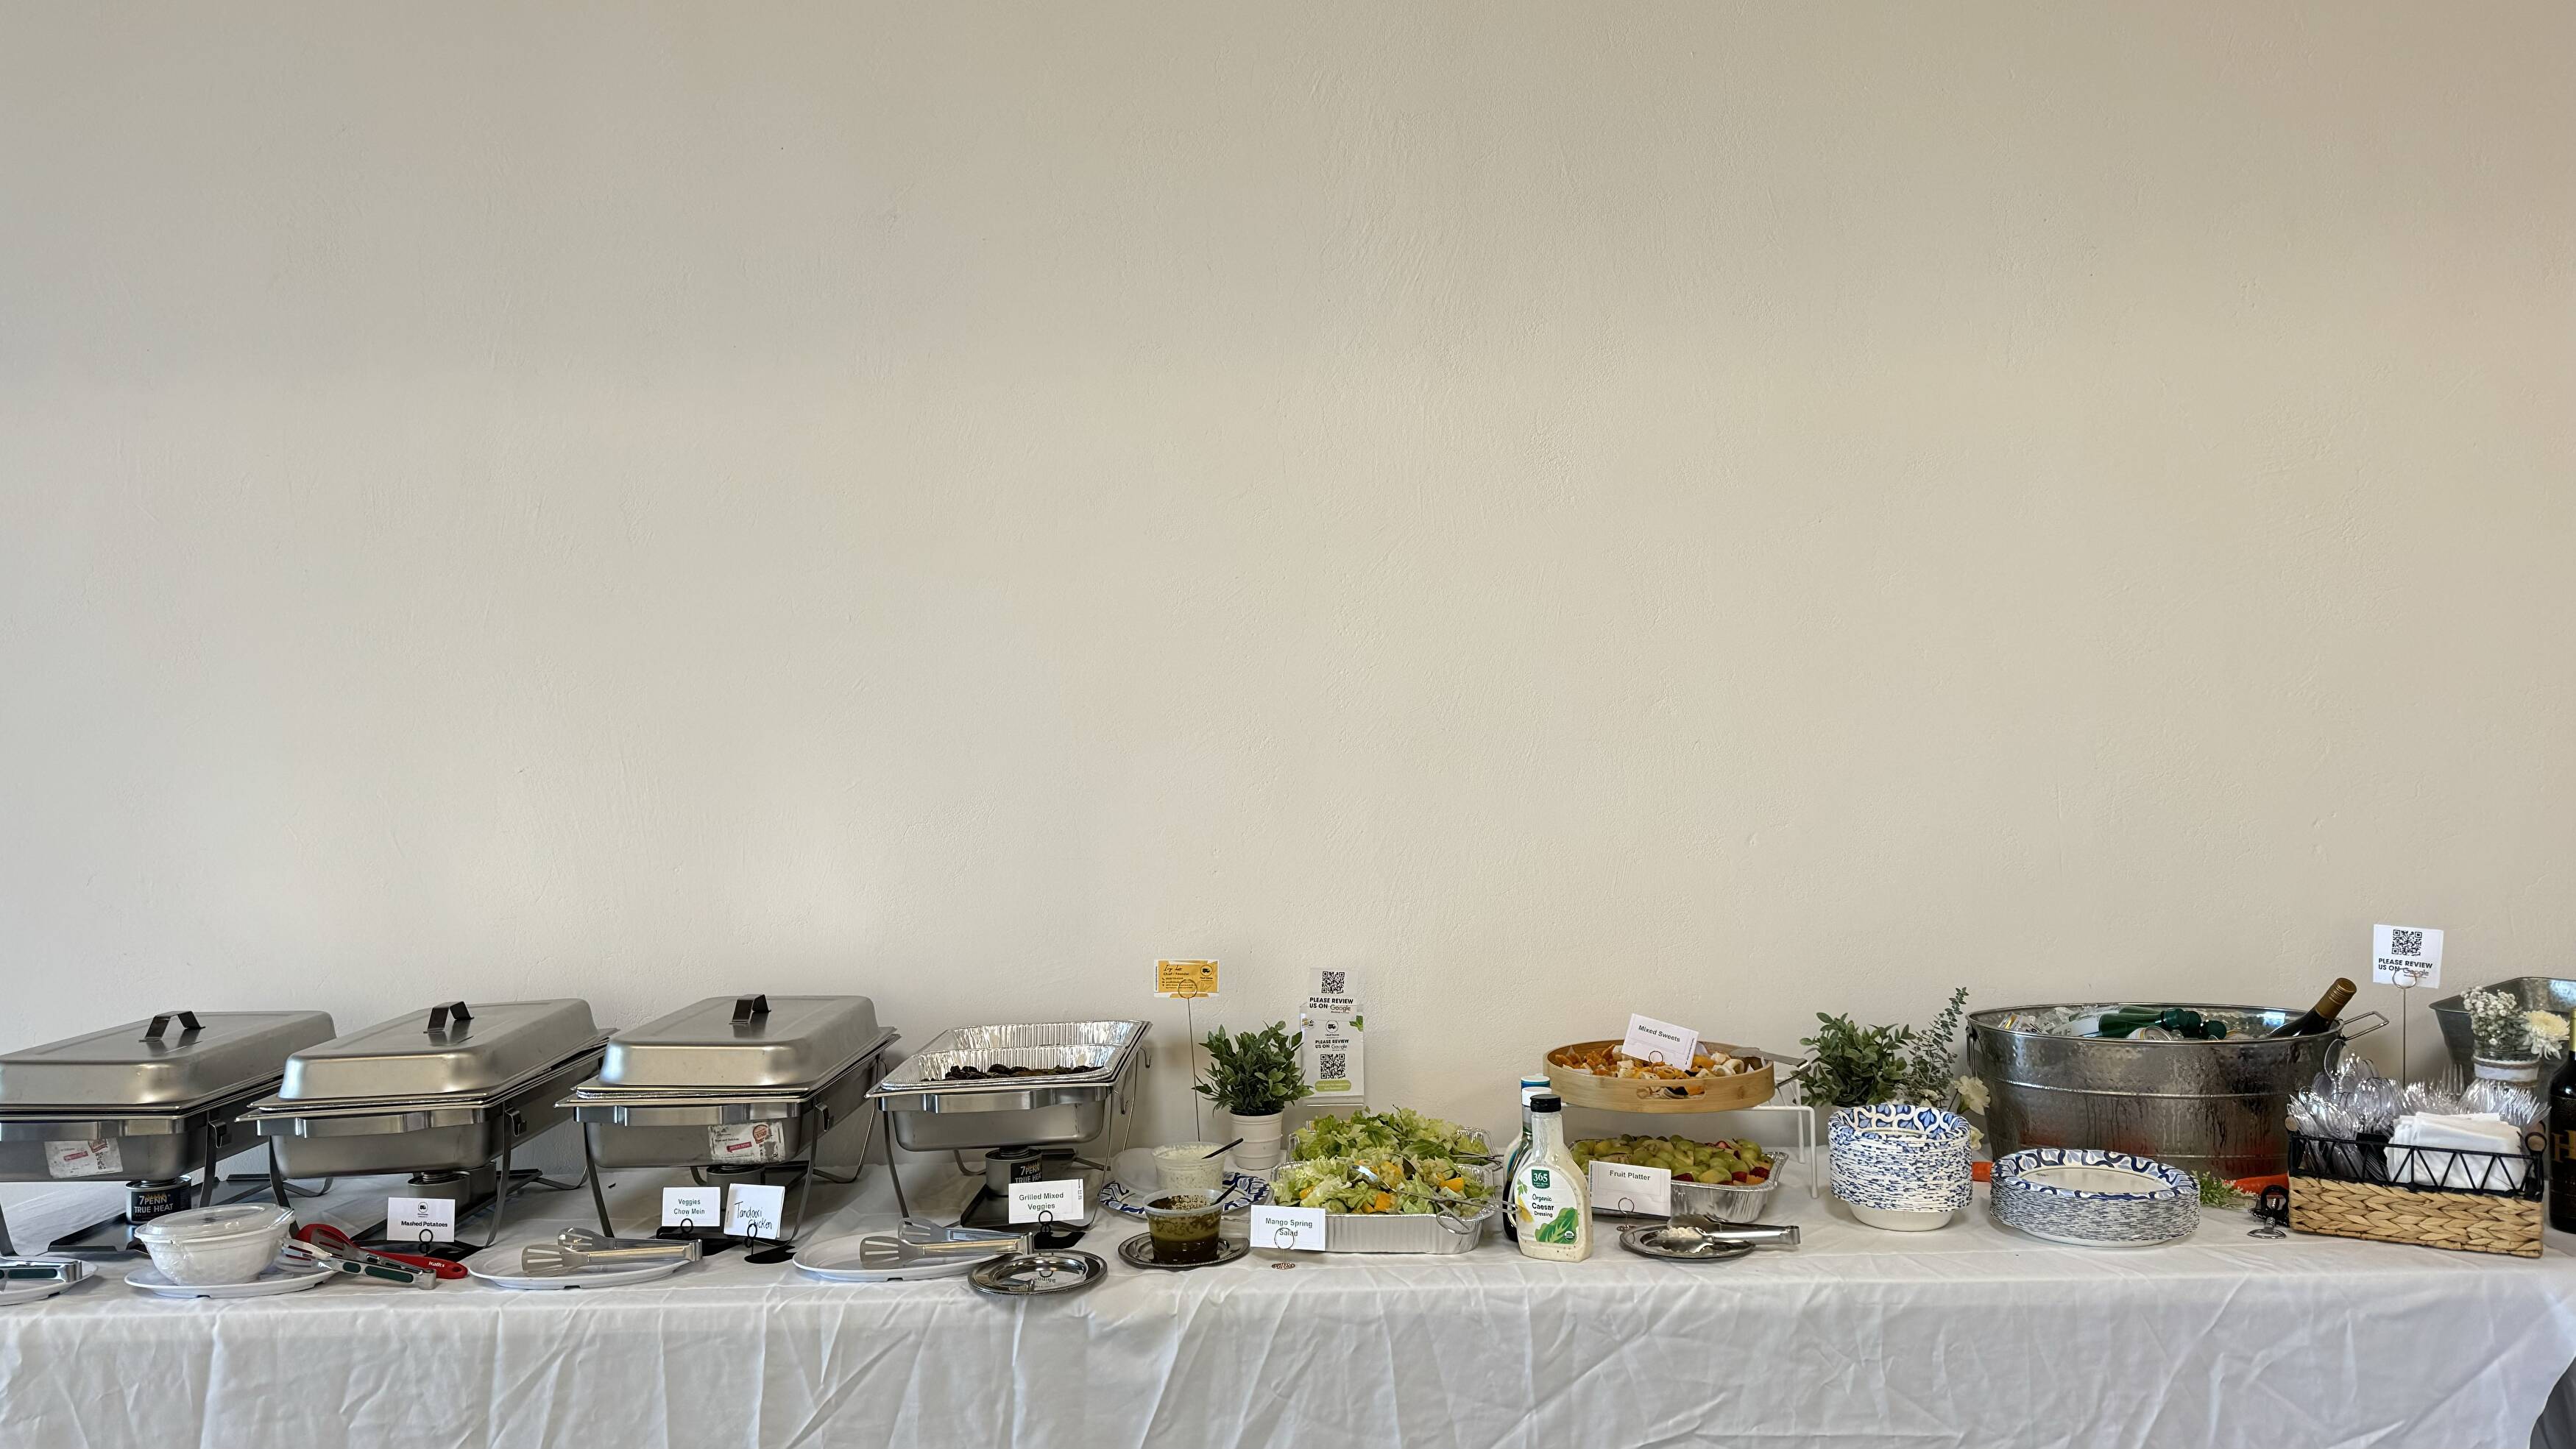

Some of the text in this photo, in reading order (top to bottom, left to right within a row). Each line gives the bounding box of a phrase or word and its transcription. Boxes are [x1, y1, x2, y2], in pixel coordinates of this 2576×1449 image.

[1638, 1025, 1680, 1042] Mixed Sweets
[1533, 1173, 1548, 1182] 365
[1532, 1194, 1552, 1202] Organic
[154, 1203, 173, 1212] HEAT
[1266, 1218, 1312, 1228] Mango Spring
